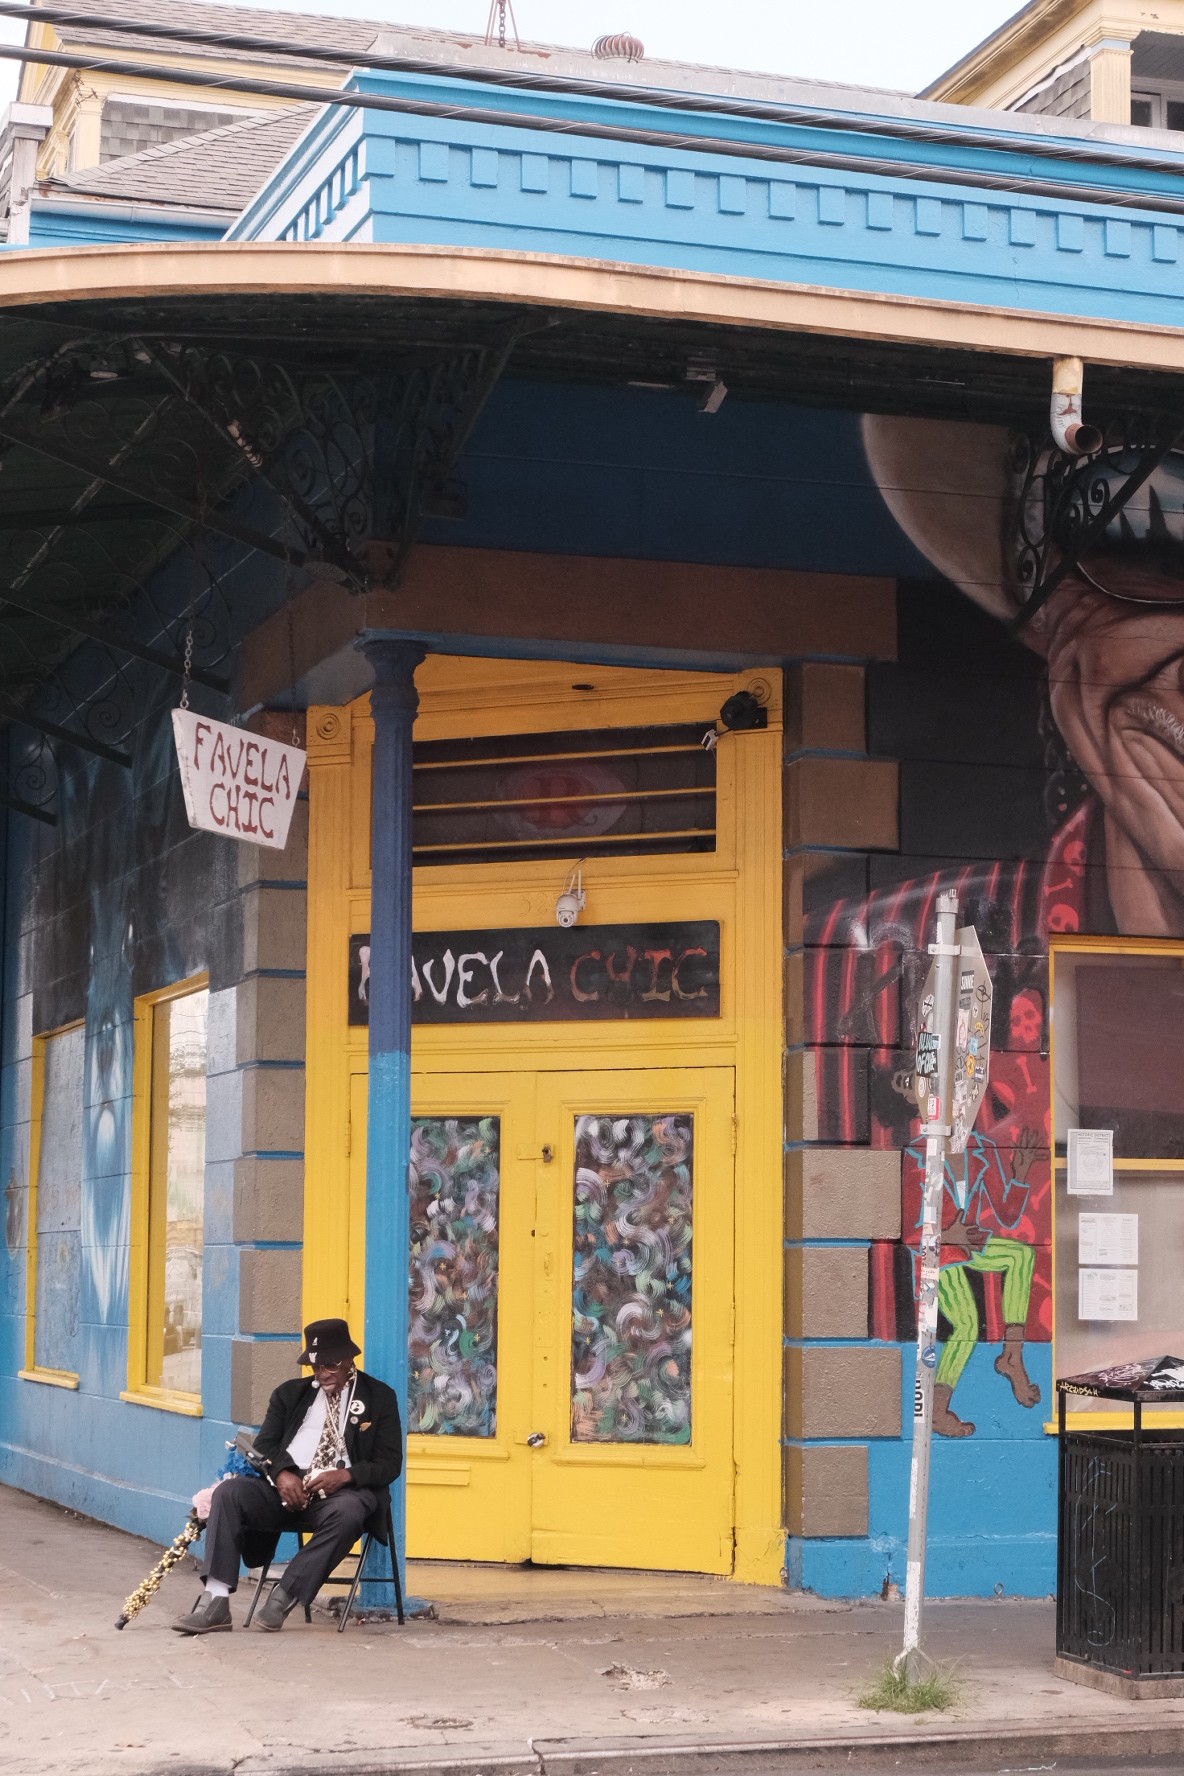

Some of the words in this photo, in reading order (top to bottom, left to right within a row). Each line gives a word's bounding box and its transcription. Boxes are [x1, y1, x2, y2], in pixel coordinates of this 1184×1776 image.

[193, 721, 291, 800] FAVELA
[209, 782, 275, 839] CHIC
[570, 944, 708, 1004] CHIC
